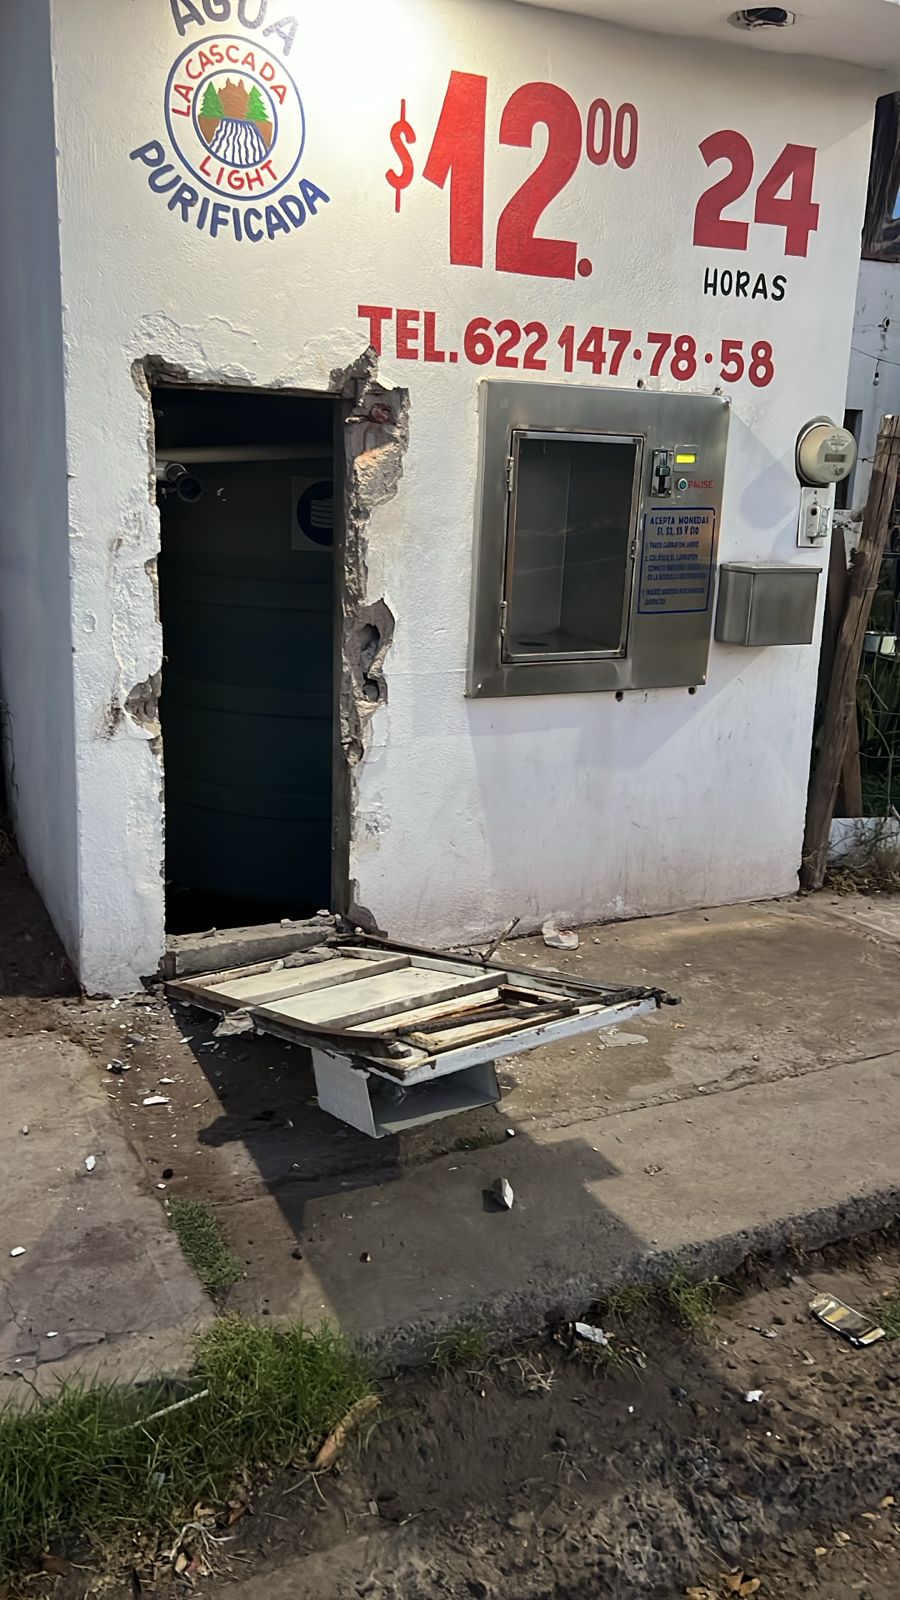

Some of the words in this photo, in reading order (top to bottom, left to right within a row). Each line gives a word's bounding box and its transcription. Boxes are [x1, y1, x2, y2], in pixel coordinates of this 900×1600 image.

[169, 0, 299, 56] AGUA
[172, 84, 194, 117] LA
[185, 44, 287, 104] CASCADA
[129, 139, 331, 243] PURIFICADA
[199, 155, 278, 191] LIGHT
[692, 129, 820, 258] 24
[703, 266, 787, 301] HORAS
[358, 304, 459, 363] TEL.
[464, 317, 549, 371] 622
[688, 480, 713, 489] PAUSE
[650, 516, 675, 525] ACEPTA
